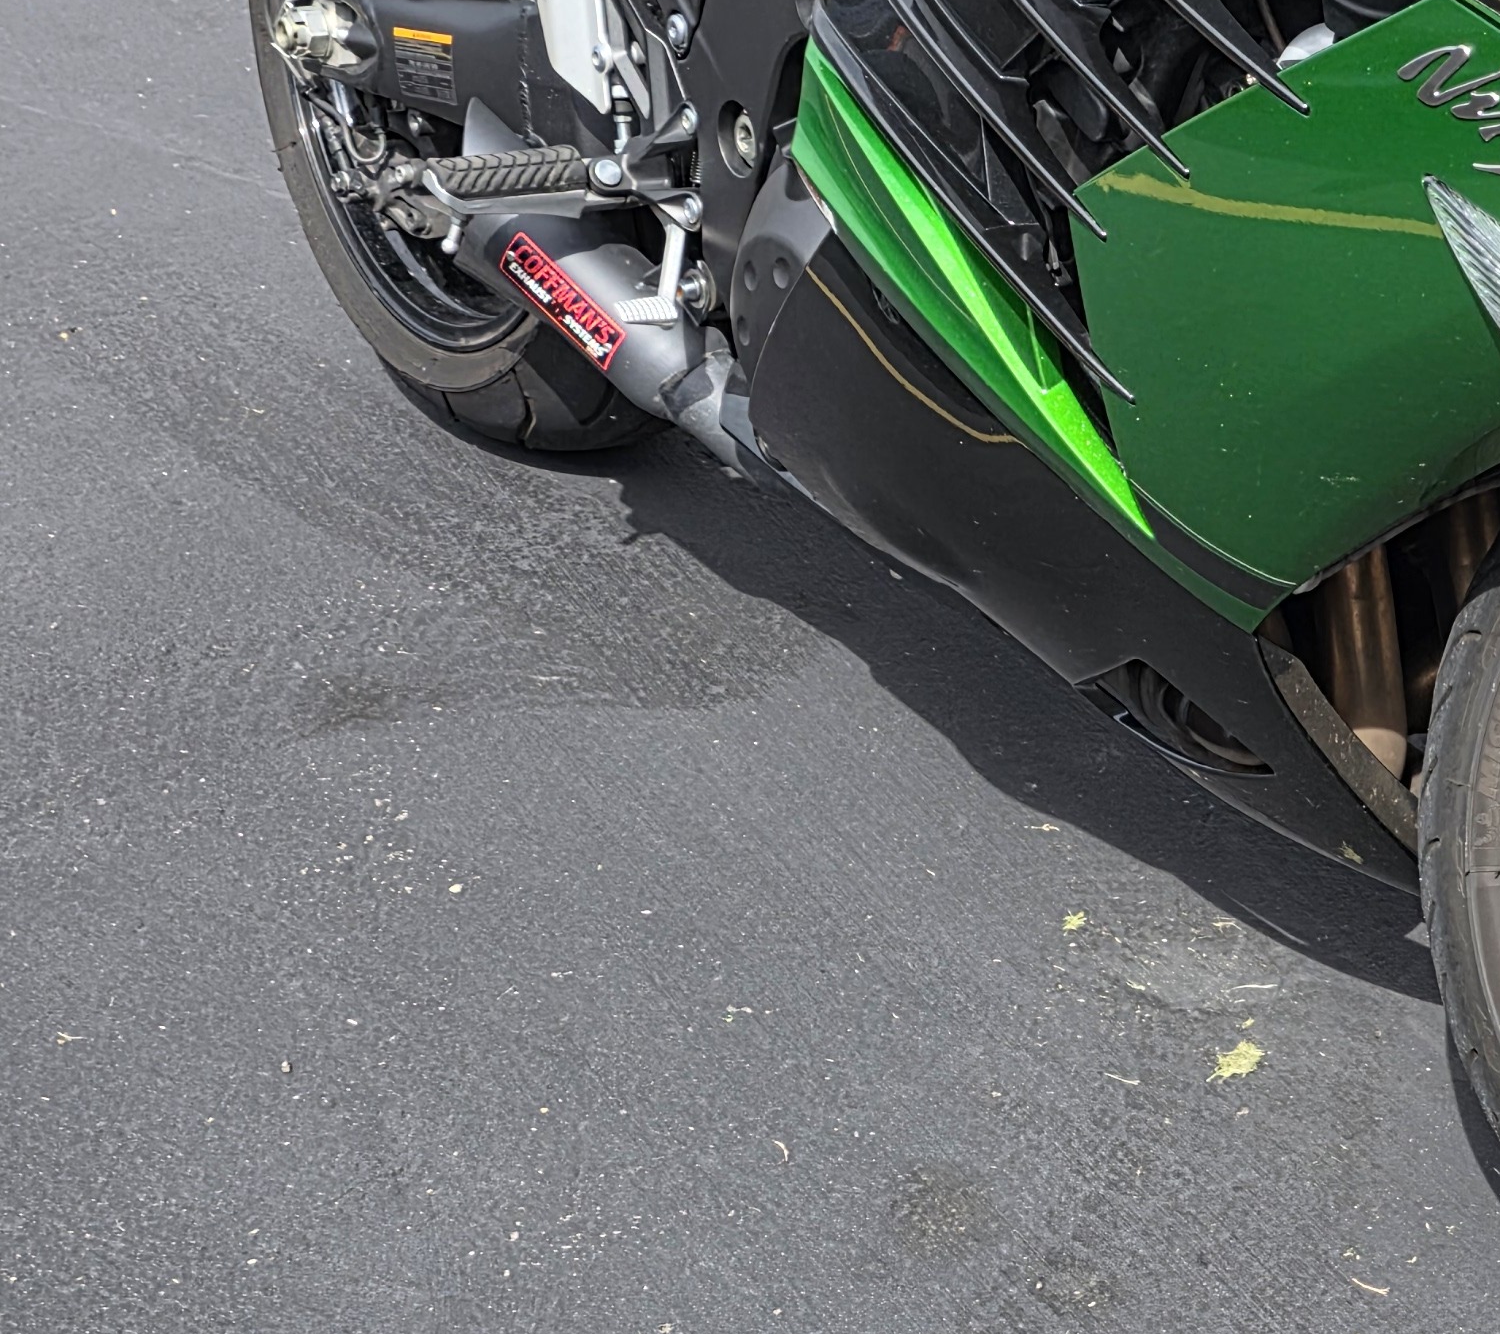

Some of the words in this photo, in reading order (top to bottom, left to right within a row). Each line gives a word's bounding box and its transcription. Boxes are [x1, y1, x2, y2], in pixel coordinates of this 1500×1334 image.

[508, 262, 553, 304] EXHAUST
[562, 314, 607, 357] SYSTEMS
[514, 244, 616, 345] COFFMAN'S
